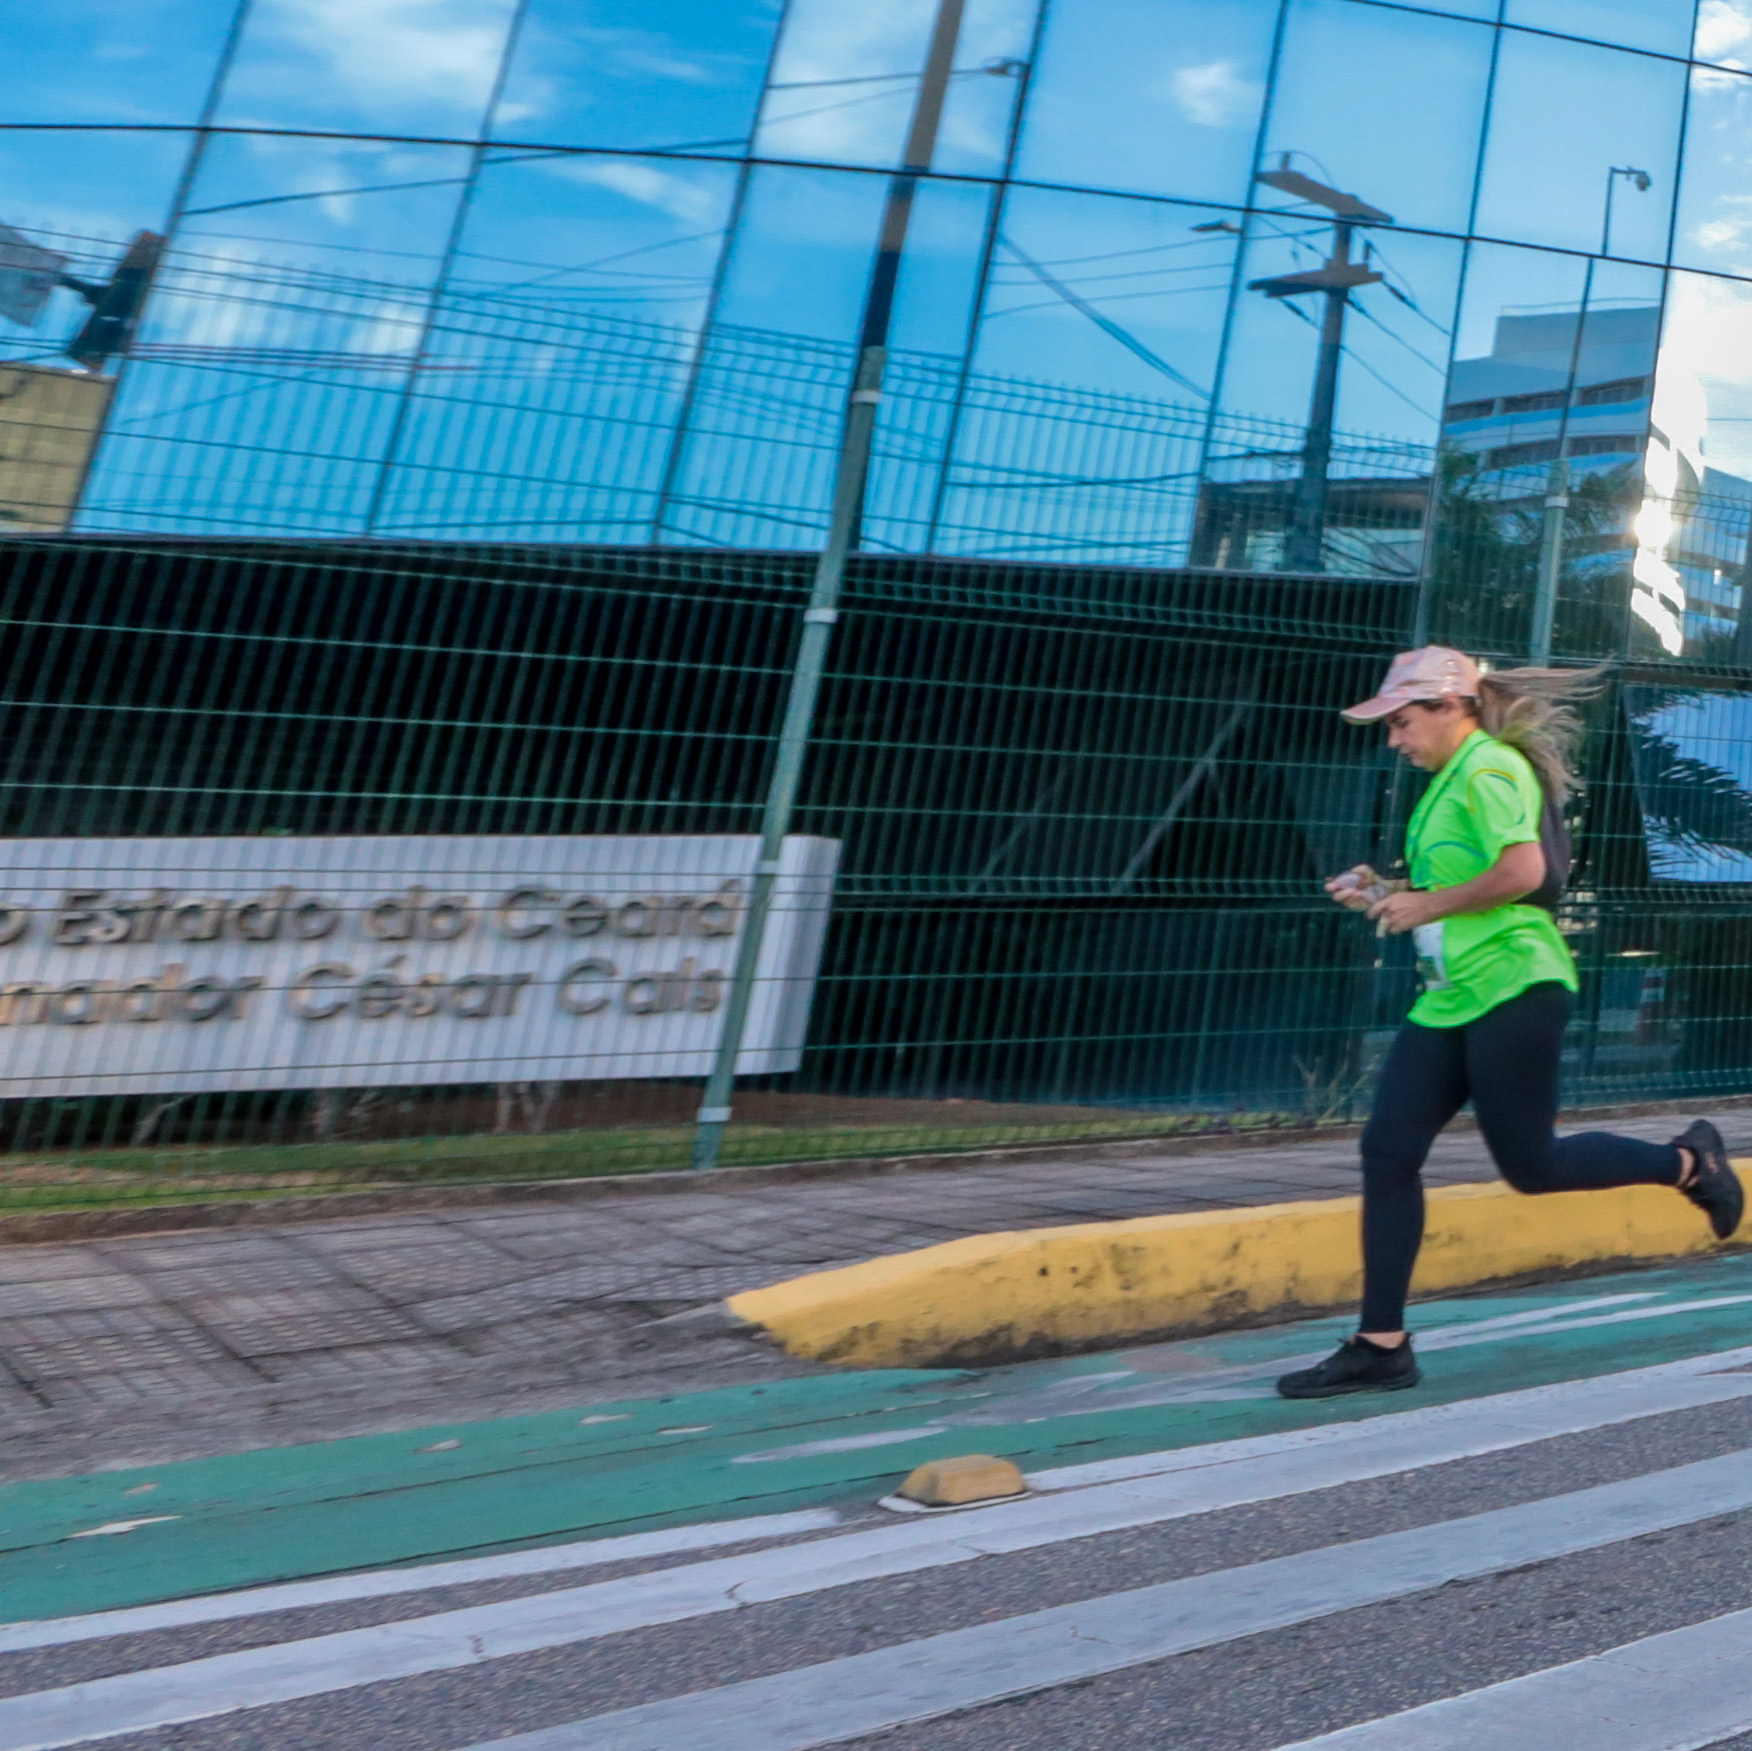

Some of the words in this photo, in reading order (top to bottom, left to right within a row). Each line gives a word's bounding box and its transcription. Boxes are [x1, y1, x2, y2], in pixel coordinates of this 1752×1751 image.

[54, 884, 341, 946] Estado
[364, 884, 478, 941] do
[499, 878, 742, 940] Ceará
[289, 954, 535, 1020] César
[558, 956, 725, 1016] Cals
